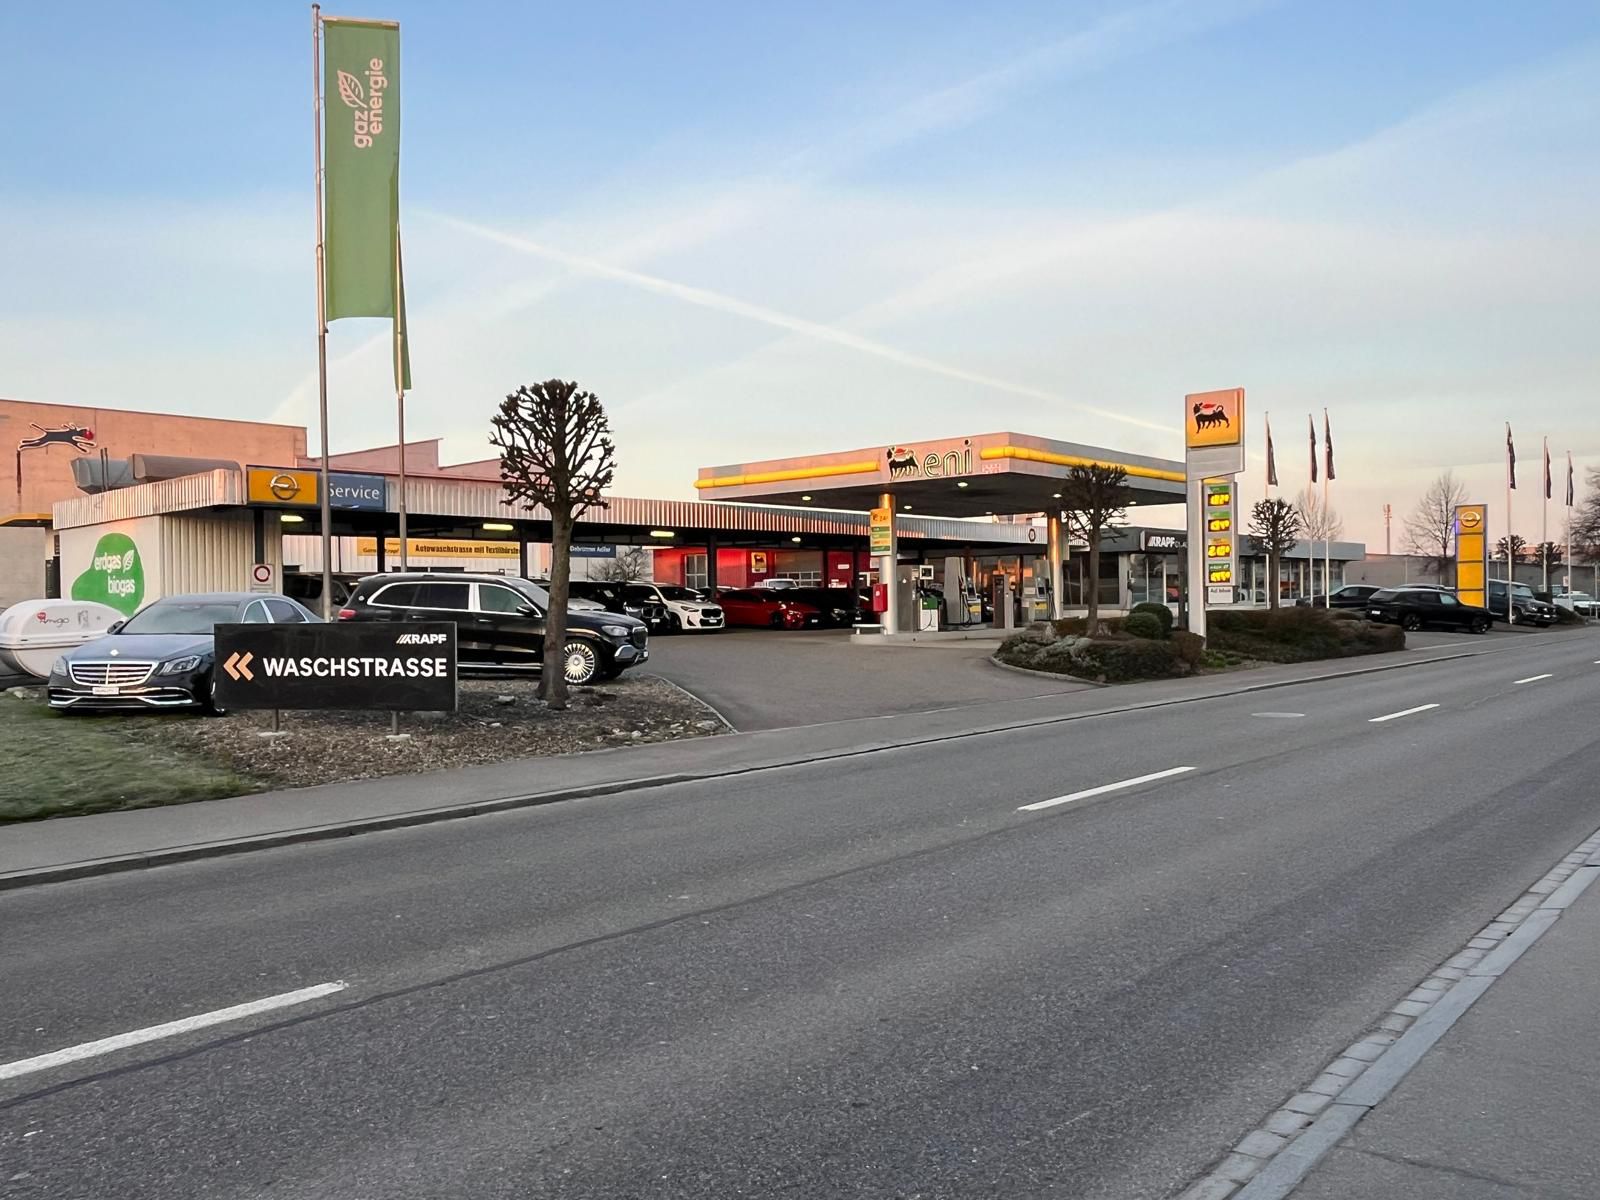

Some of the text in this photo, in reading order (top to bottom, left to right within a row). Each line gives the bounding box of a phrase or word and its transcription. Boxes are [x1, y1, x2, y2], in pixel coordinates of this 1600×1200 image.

[365, 58, 388, 134] energie
[354, 111, 373, 148] gaz
[924, 439, 973, 478] eni
[486, 546, 519, 555] Textilbürste
[94, 552, 122, 573] erdgas
[107, 575, 136, 597] biogas
[397, 634, 447, 644] KRAPF
[263, 657, 447, 677] WASCHSTRASSE
